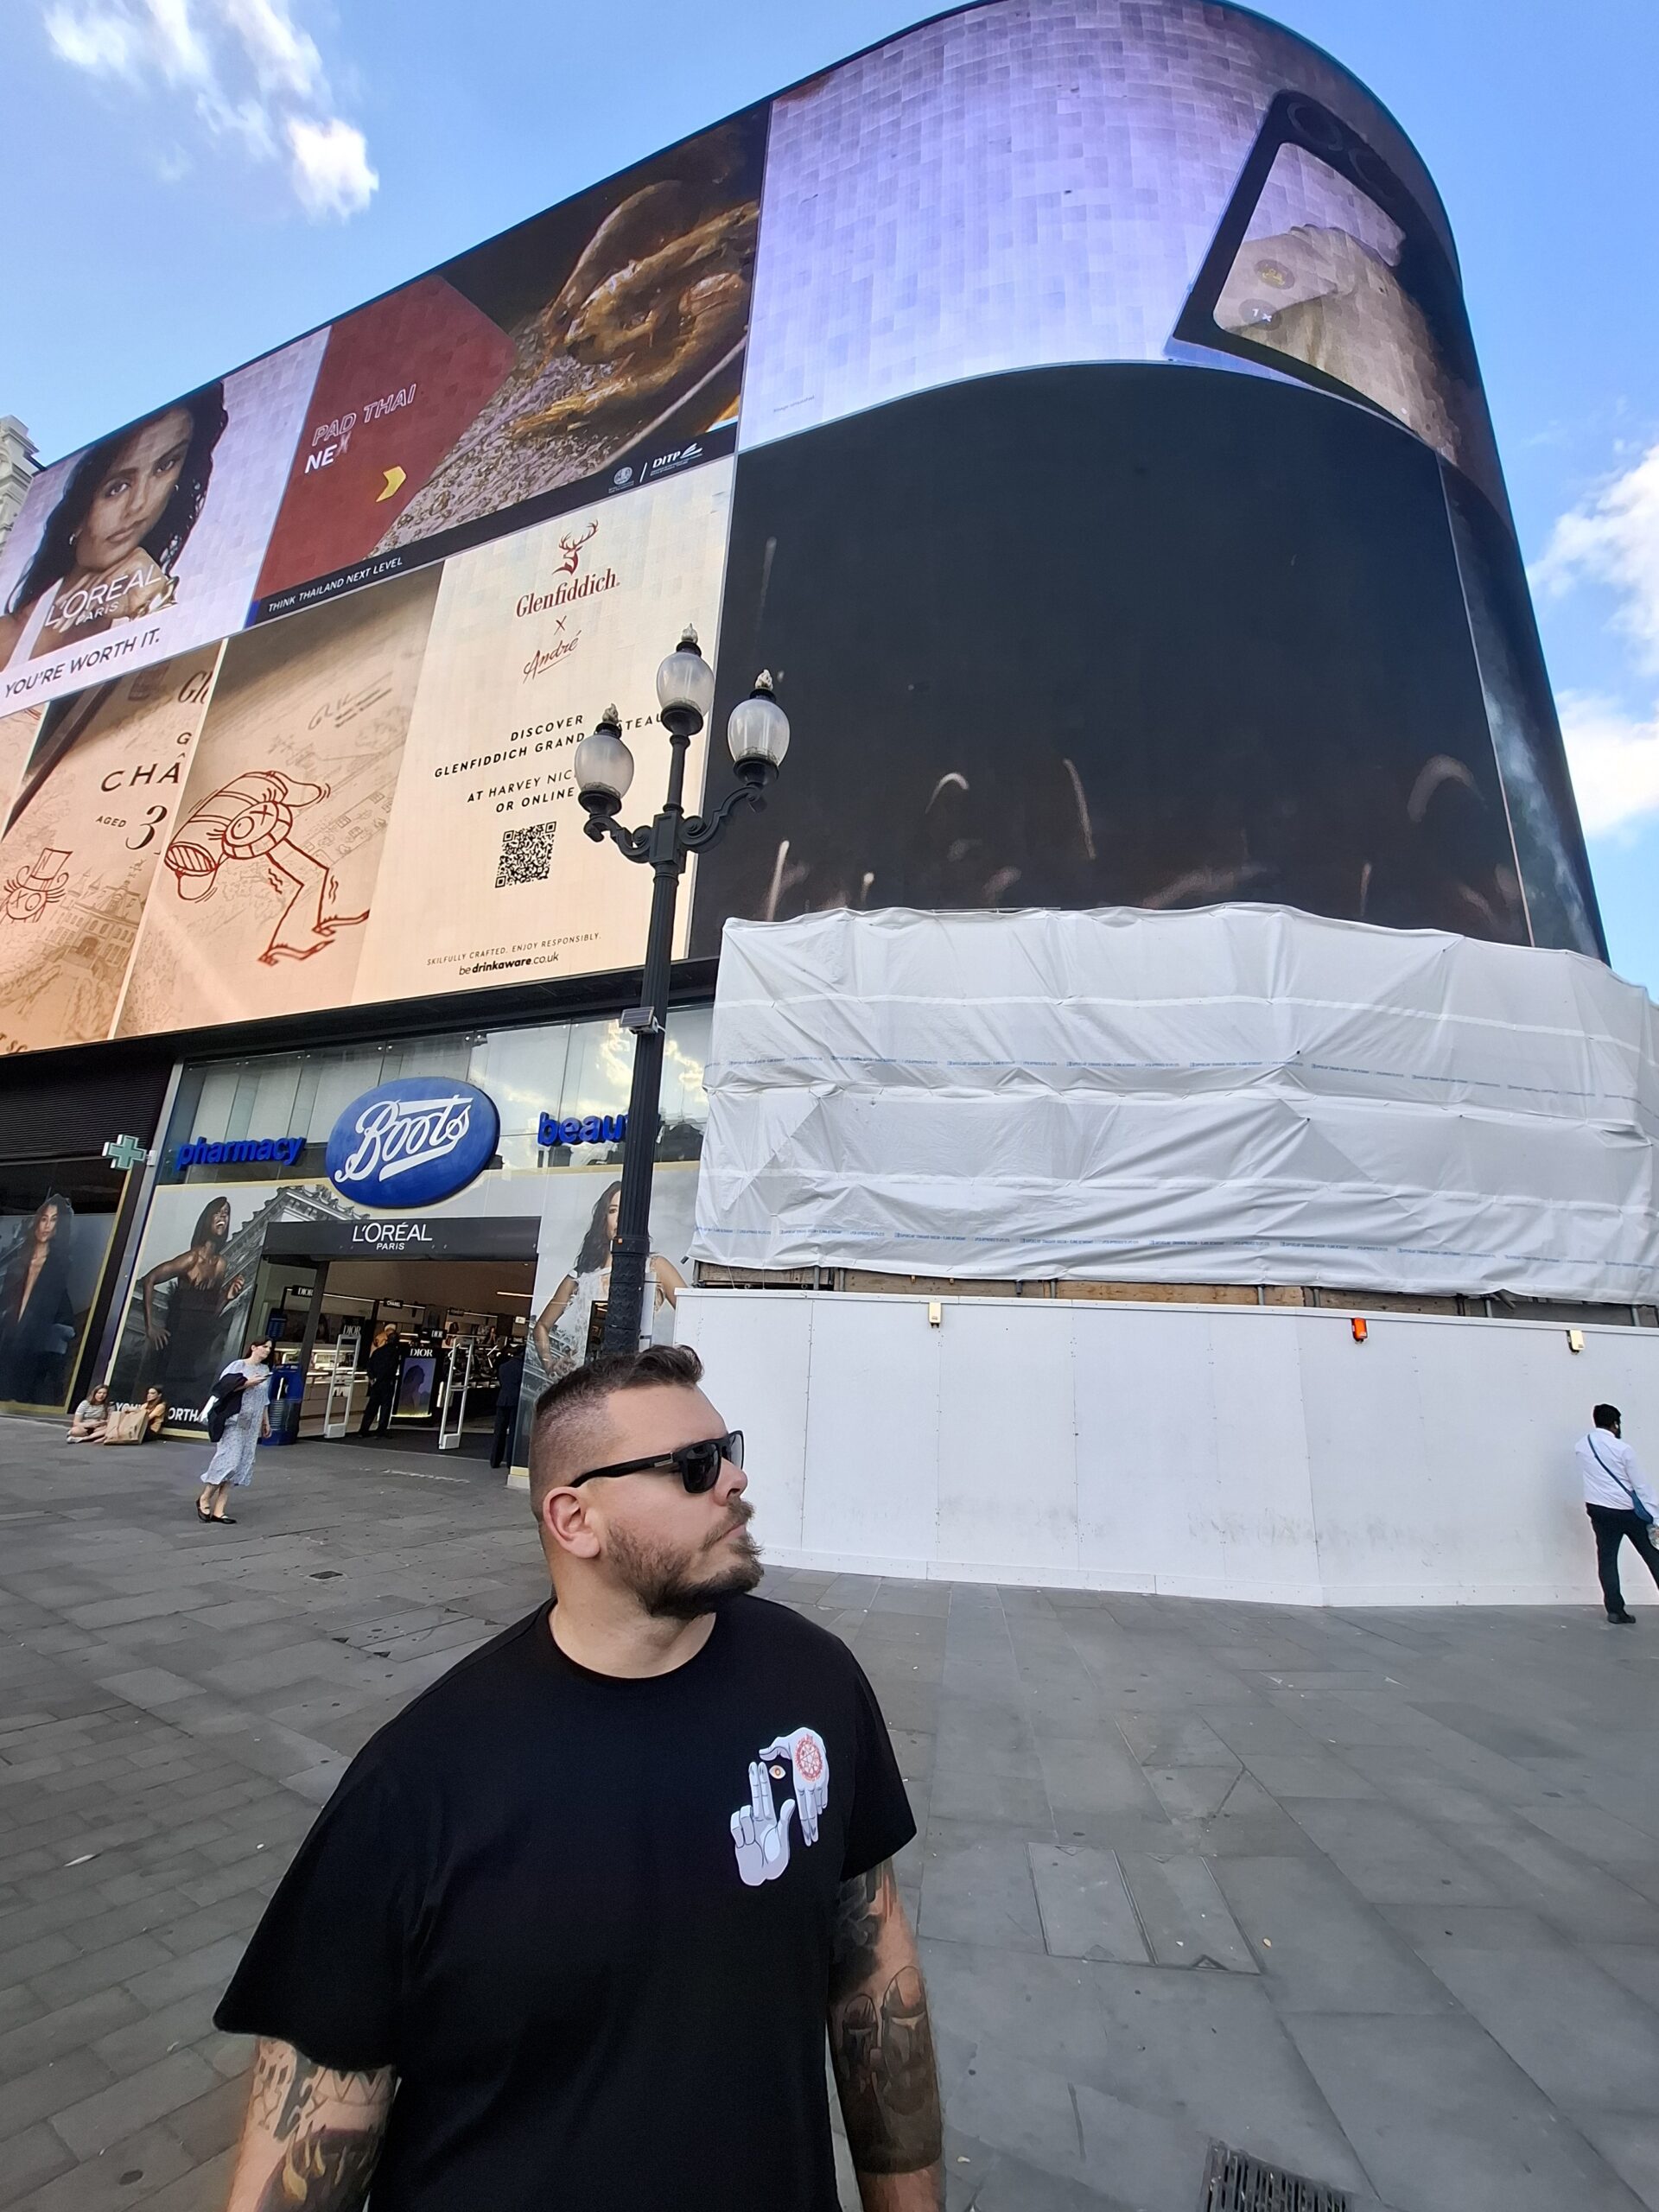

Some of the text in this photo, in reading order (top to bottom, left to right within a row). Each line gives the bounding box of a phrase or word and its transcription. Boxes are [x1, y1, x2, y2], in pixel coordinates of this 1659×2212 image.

[312, 383, 416, 447] PAD THAI
[652, 450, 681, 469] DITP
[269, 556, 404, 613] THINK THAILAND NEXT LEVEL
[516, 568, 617, 618] Glenfiddich
[75, 601, 119, 626] PARIS
[5, 627, 161, 698] YOU'RE WORTH IT.
[522, 629, 582, 684] André
[510, 715, 584, 741] DISCOVER
[434, 747, 528, 778] GLENFIDDICH
[534, 732, 585, 753] GRAND
[467, 790, 485, 804] AT
[488, 777, 541, 798] HARVEY
[495, 786, 575, 813] OR ONLINE
[95, 804, 168, 850] AGED 3
[427, 932, 601, 966] SKILFULLY CRAFTED. ENJOY RESPONSIBLY.
[335, 1094, 474, 1183] Boots
[537, 1111, 629, 1147] beau
[177, 1136, 306, 1170] pharmacy
[352, 1222, 433, 1243] L'ORÉAL
[297, 1287, 314, 1296] DIOR
[343, 1325, 361, 1336] DIOR
[410, 1348, 433, 1357] DIOR
[168, 1408, 199, 1422] ORTH
